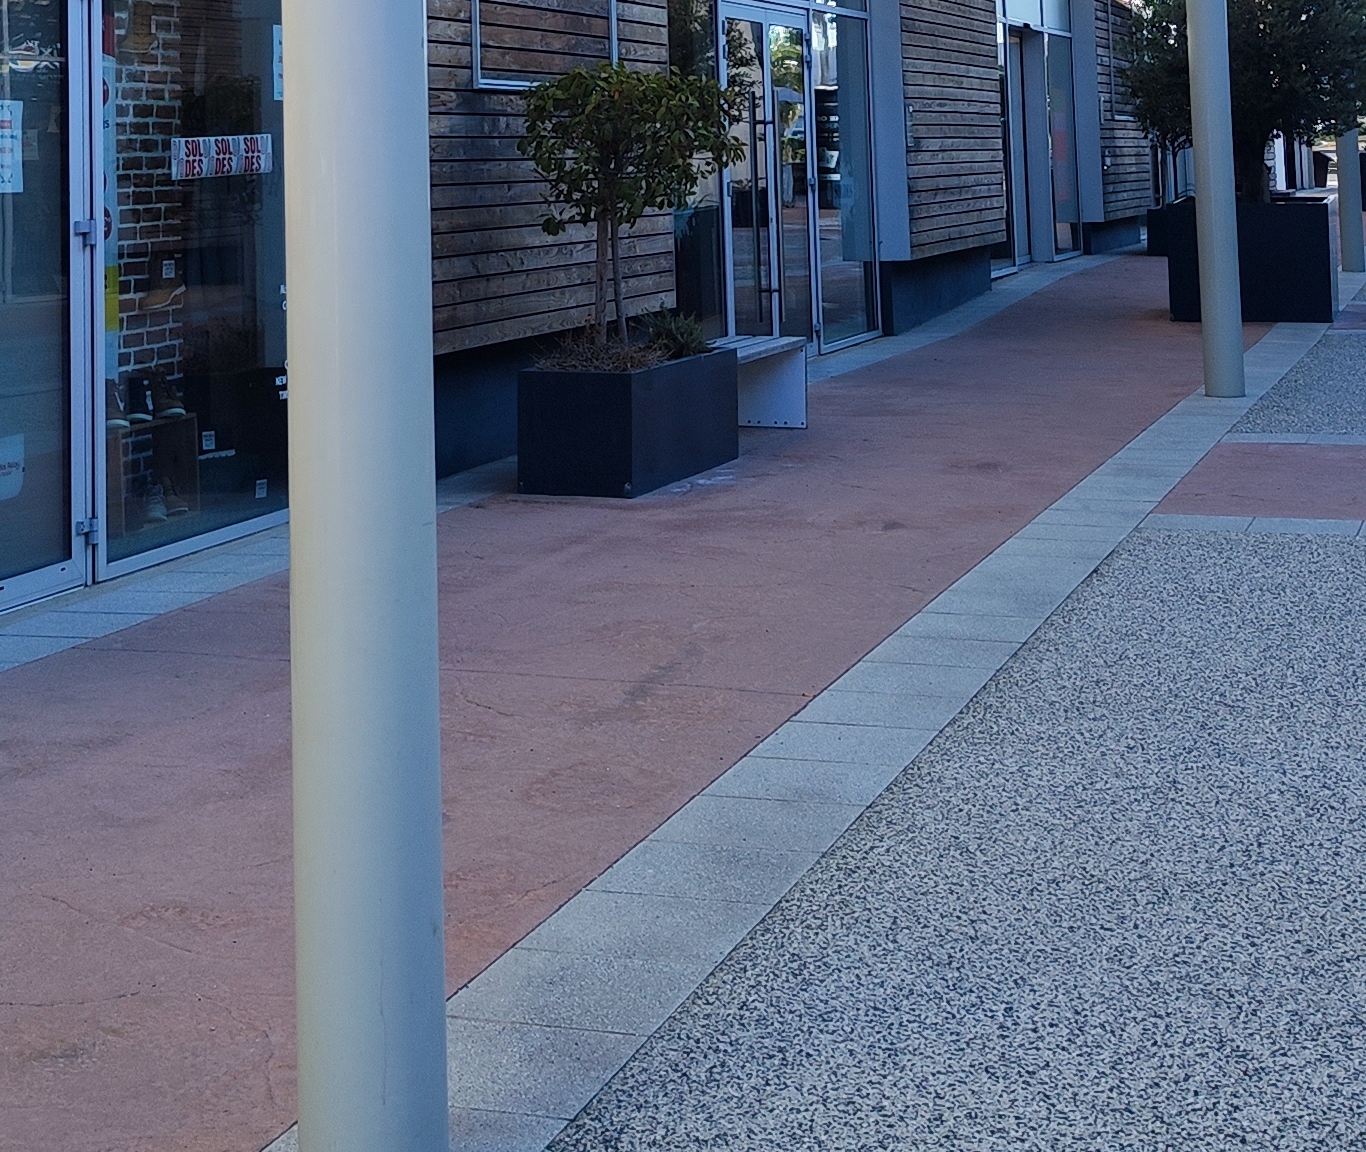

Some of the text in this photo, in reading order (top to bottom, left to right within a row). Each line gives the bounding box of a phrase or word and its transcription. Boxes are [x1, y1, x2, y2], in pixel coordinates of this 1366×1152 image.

[185, 139, 204, 158] SOL
[214, 138, 233, 157] SOL
[243, 136, 261, 154] SOL
[185, 155, 262, 178] DES DES DES
